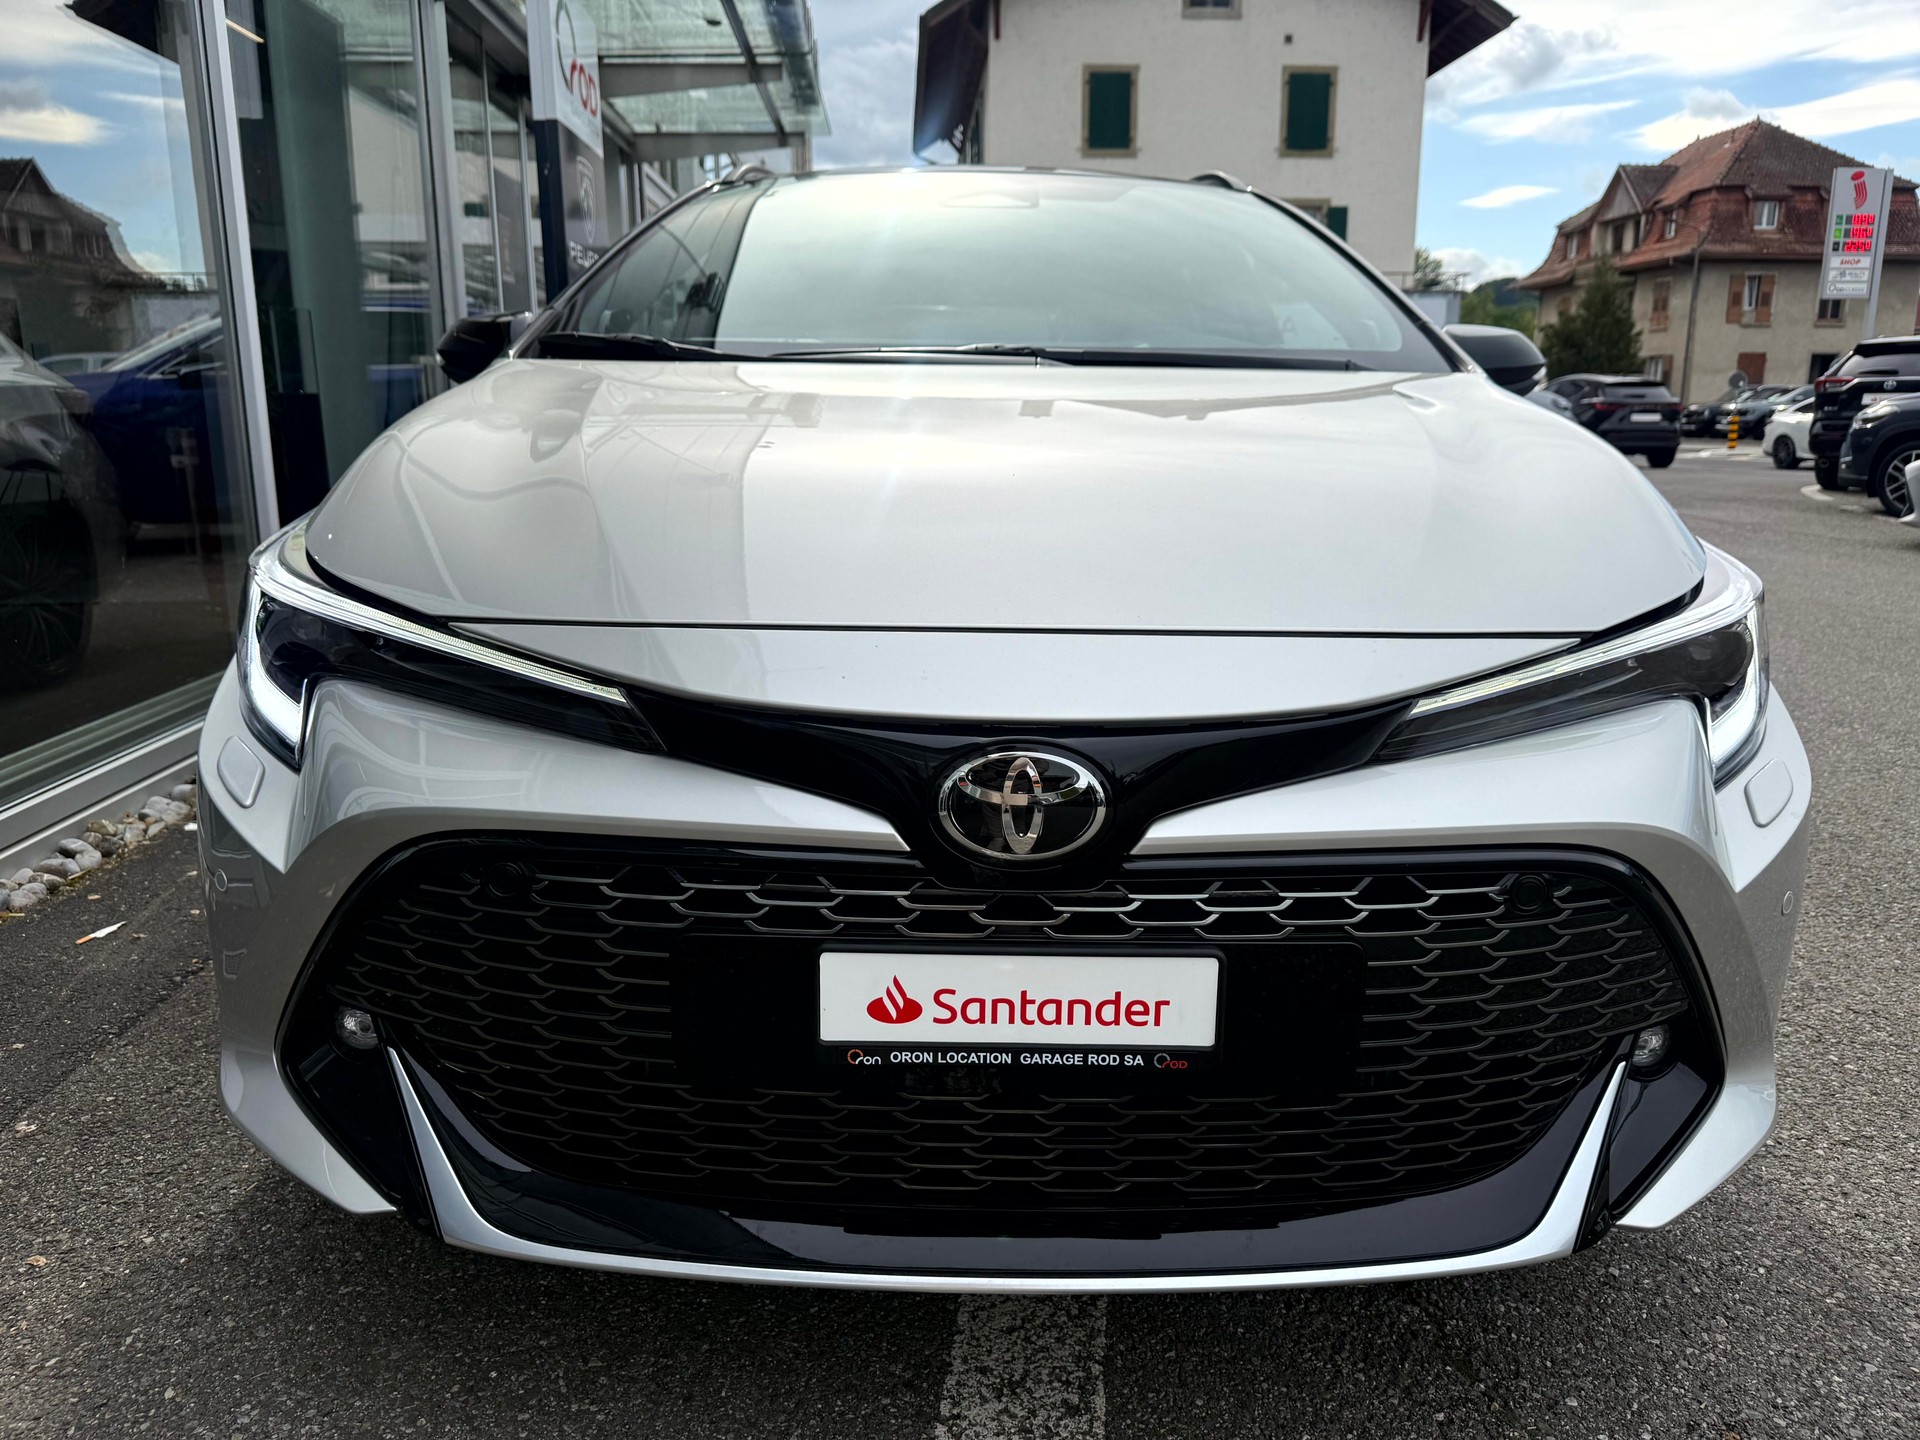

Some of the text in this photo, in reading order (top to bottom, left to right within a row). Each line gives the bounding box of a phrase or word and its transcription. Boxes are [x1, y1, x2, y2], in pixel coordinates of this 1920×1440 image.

[932, 988, 1171, 1028] Santander
[890, 1051, 933, 1064] ORON
[938, 1052, 1012, 1065] LOCATION
[1020, 1053, 1083, 1065] GARAGE
[1088, 1054, 1120, 1066] ROD
[1124, 1055, 1144, 1067] SA
